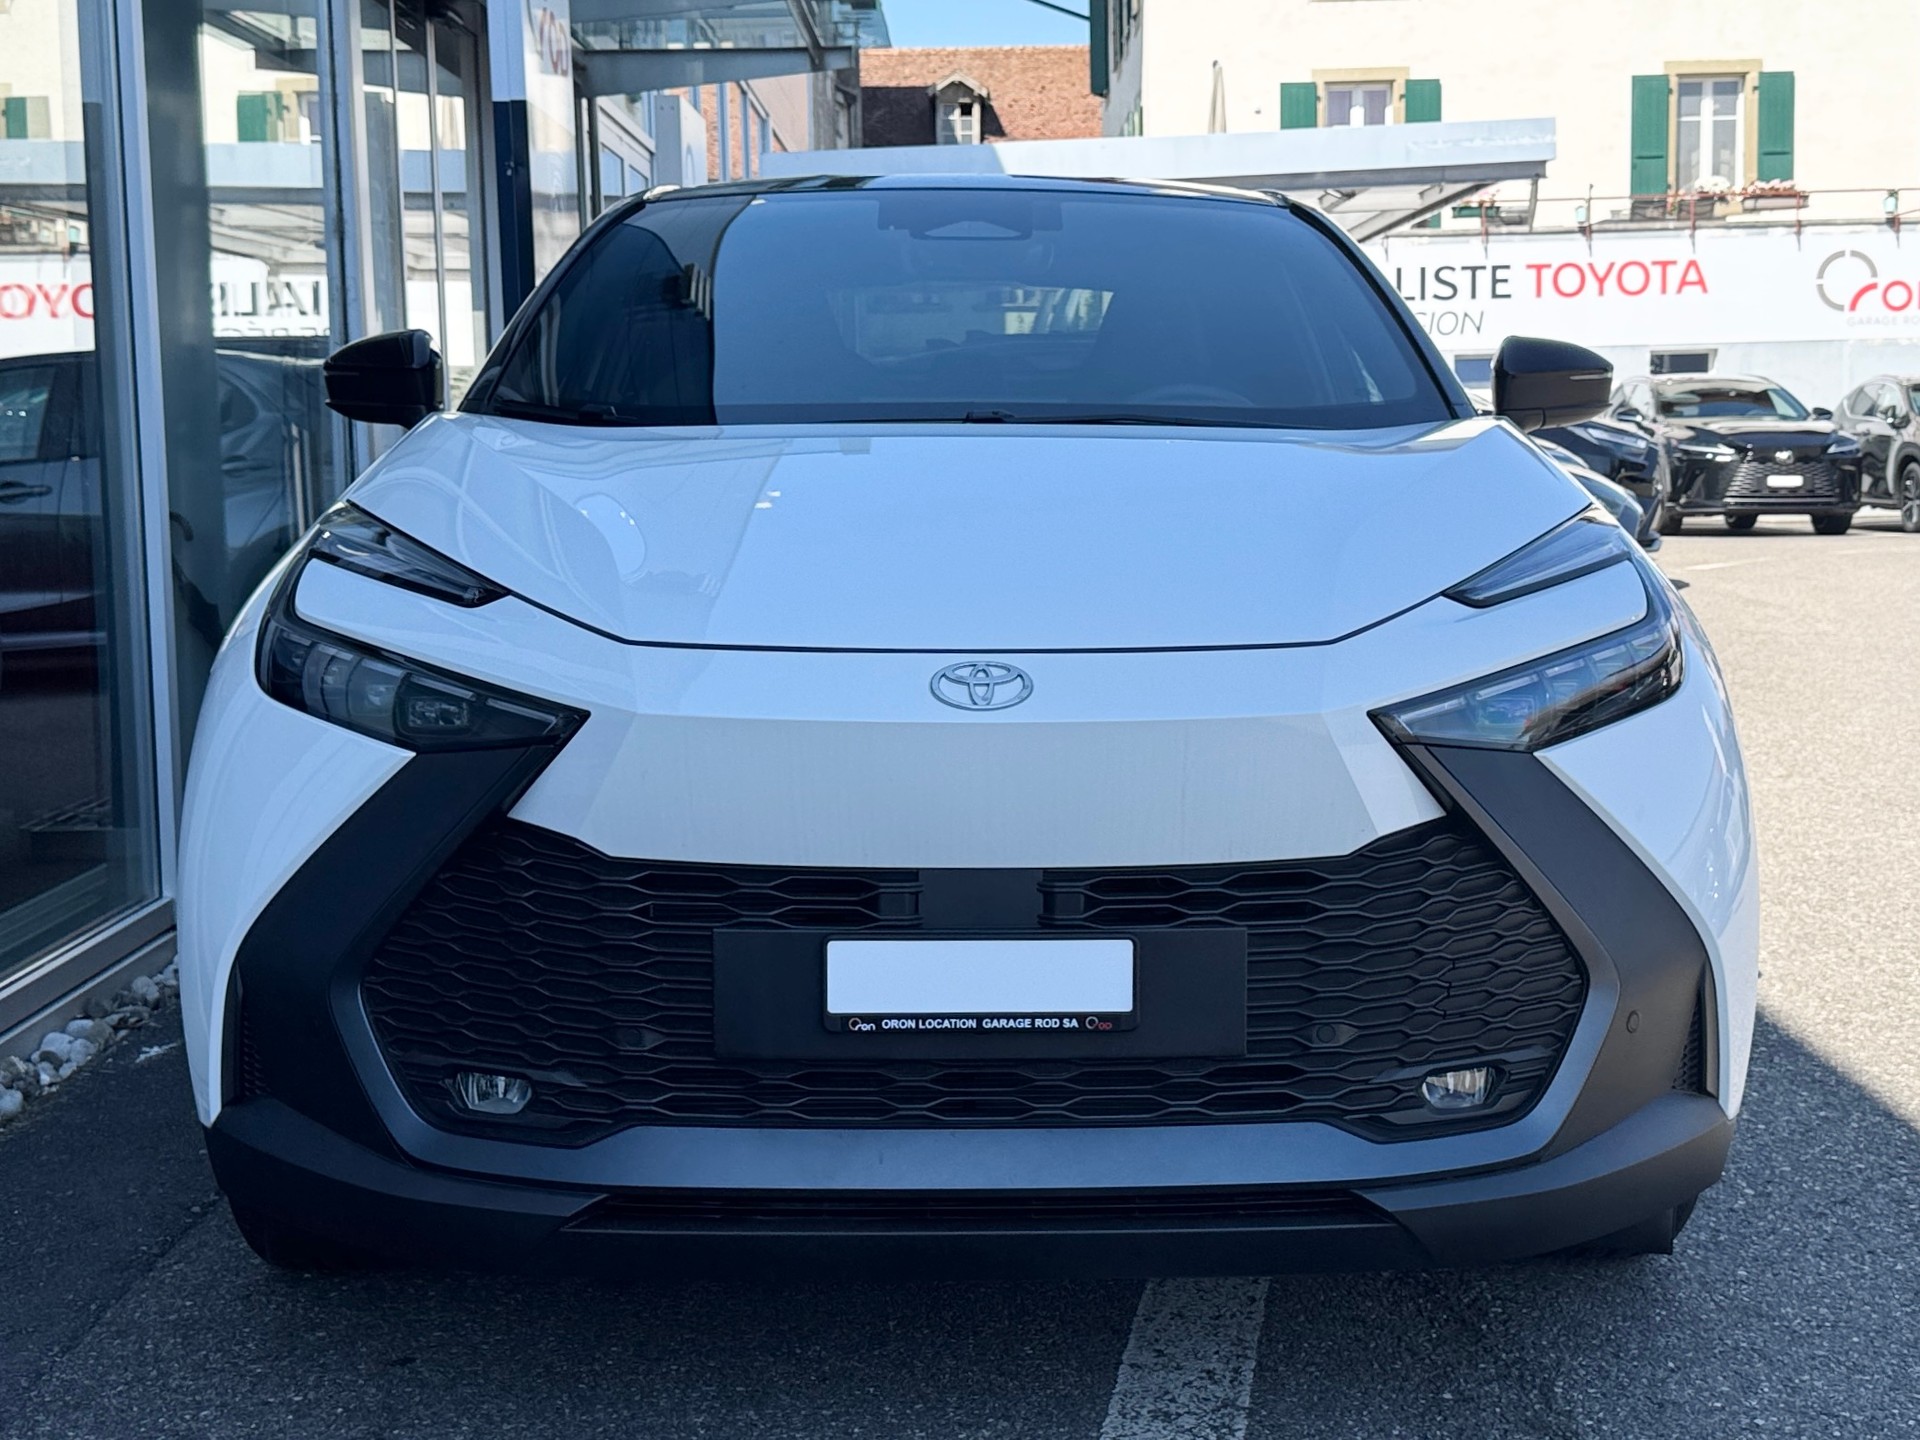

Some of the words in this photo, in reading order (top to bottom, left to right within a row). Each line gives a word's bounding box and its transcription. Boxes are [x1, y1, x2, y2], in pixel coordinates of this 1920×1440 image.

[1396, 265, 1512, 301] LISTE
[1525, 259, 1708, 299] TOYOTA
[881, 1019, 916, 1029] ORON
[918, 1018, 977, 1029] LOCATION
[982, 1018, 1032, 1028] GARAGE
[1034, 1018, 1060, 1028] ROD
[1062, 1018, 1079, 1028] SA
